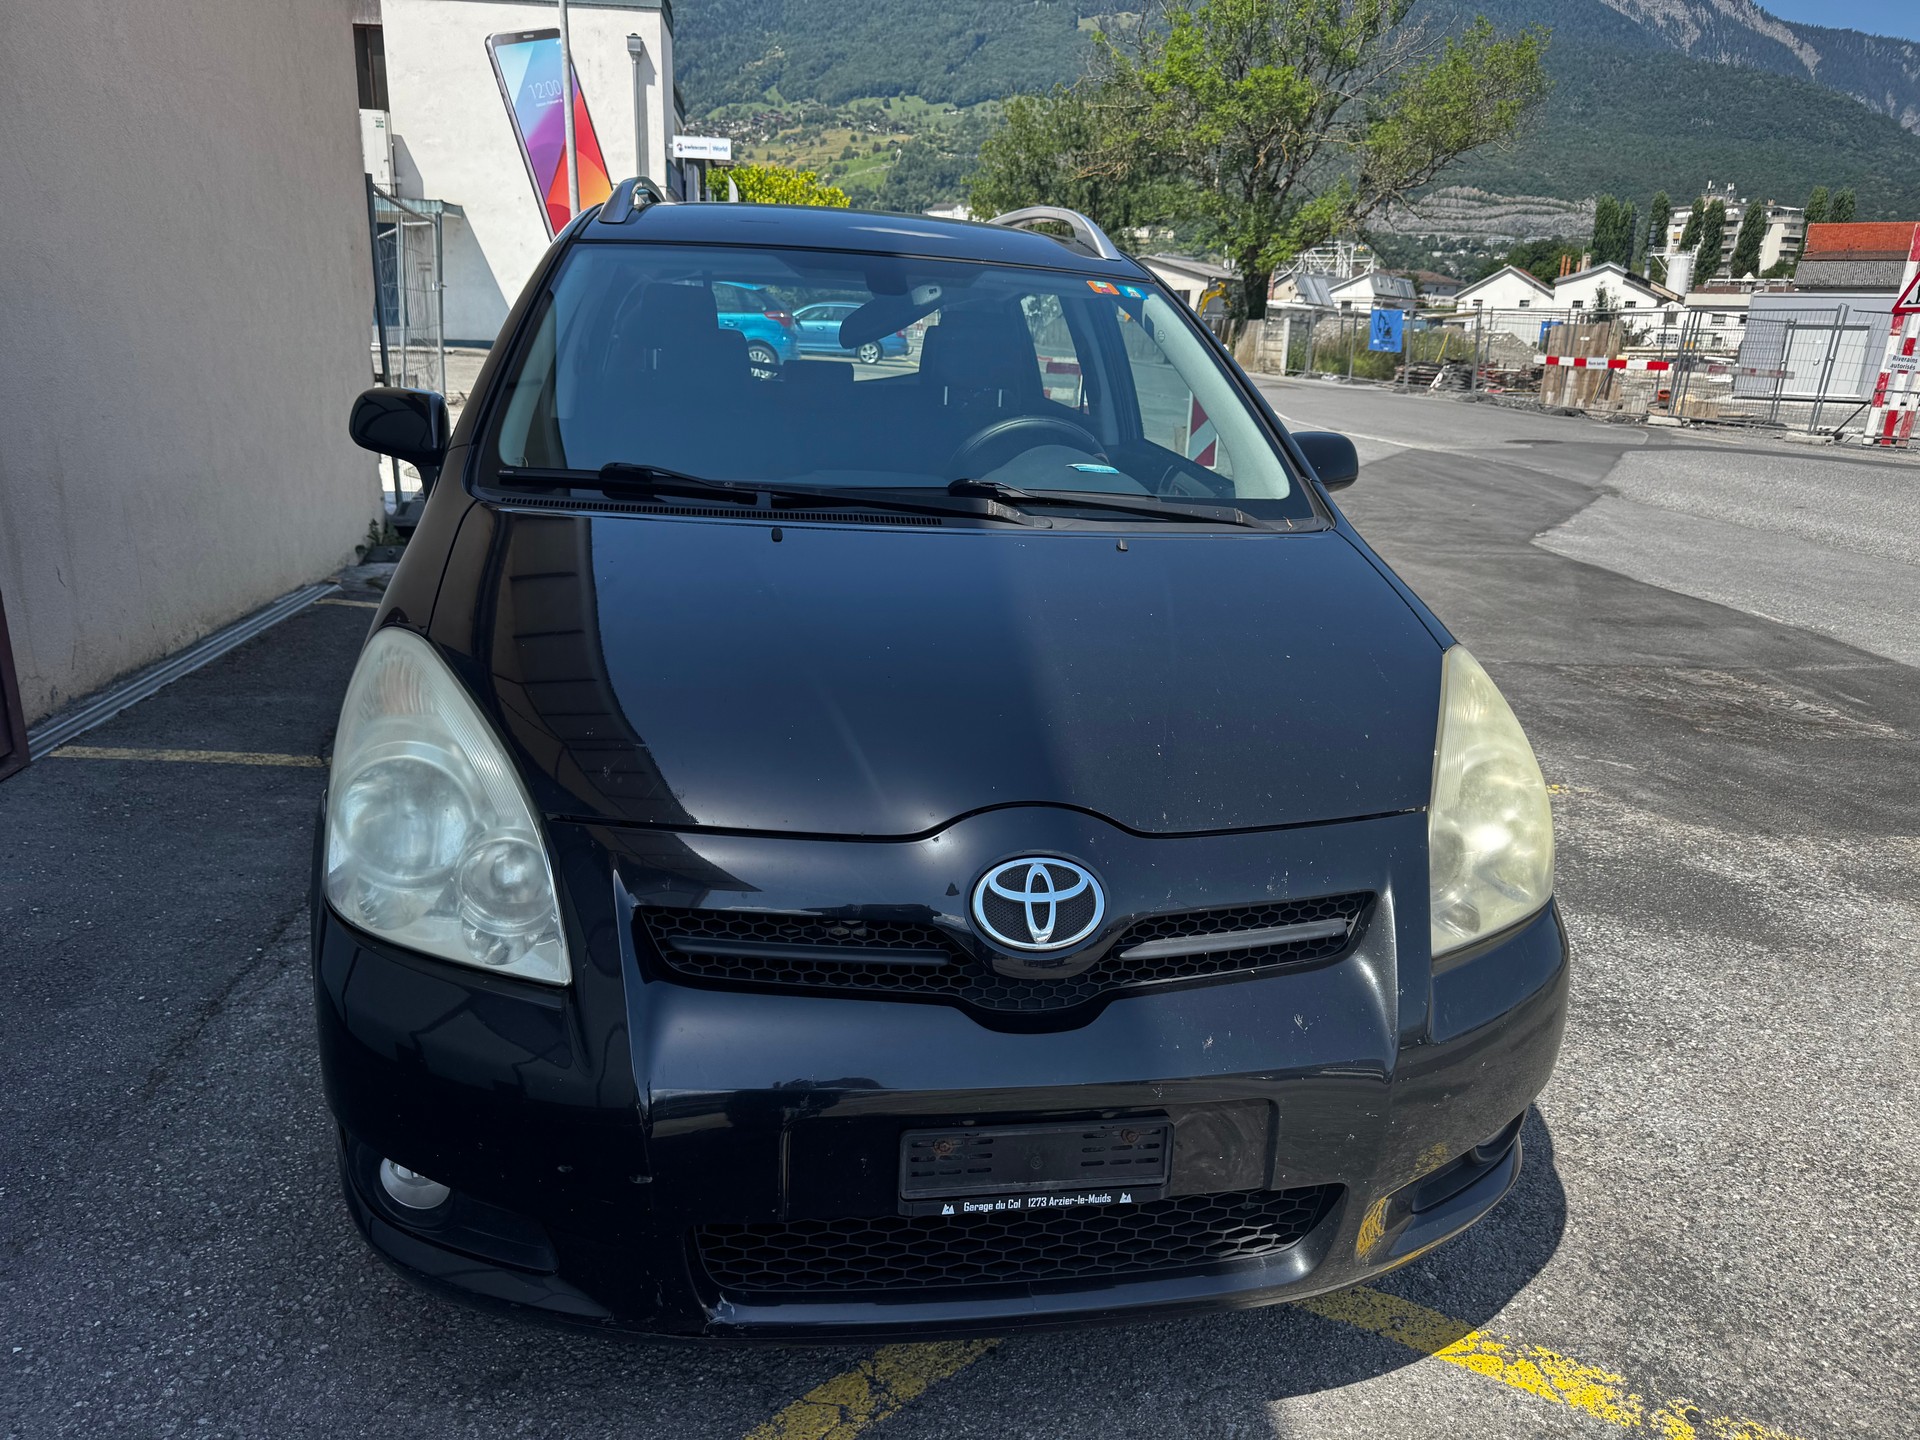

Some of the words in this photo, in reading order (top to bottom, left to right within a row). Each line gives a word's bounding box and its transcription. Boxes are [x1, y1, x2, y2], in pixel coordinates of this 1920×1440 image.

[527, 79, 562, 99] 12:00
[1892, 355, 1918, 363] Riverains
[995, 1200, 1006, 1210] du
[1007, 1198, 1021, 1209] Col
[1027, 1197, 1047, 1208] 1273
[1048, 1193, 1111, 1206] Arzier-le-Muids
